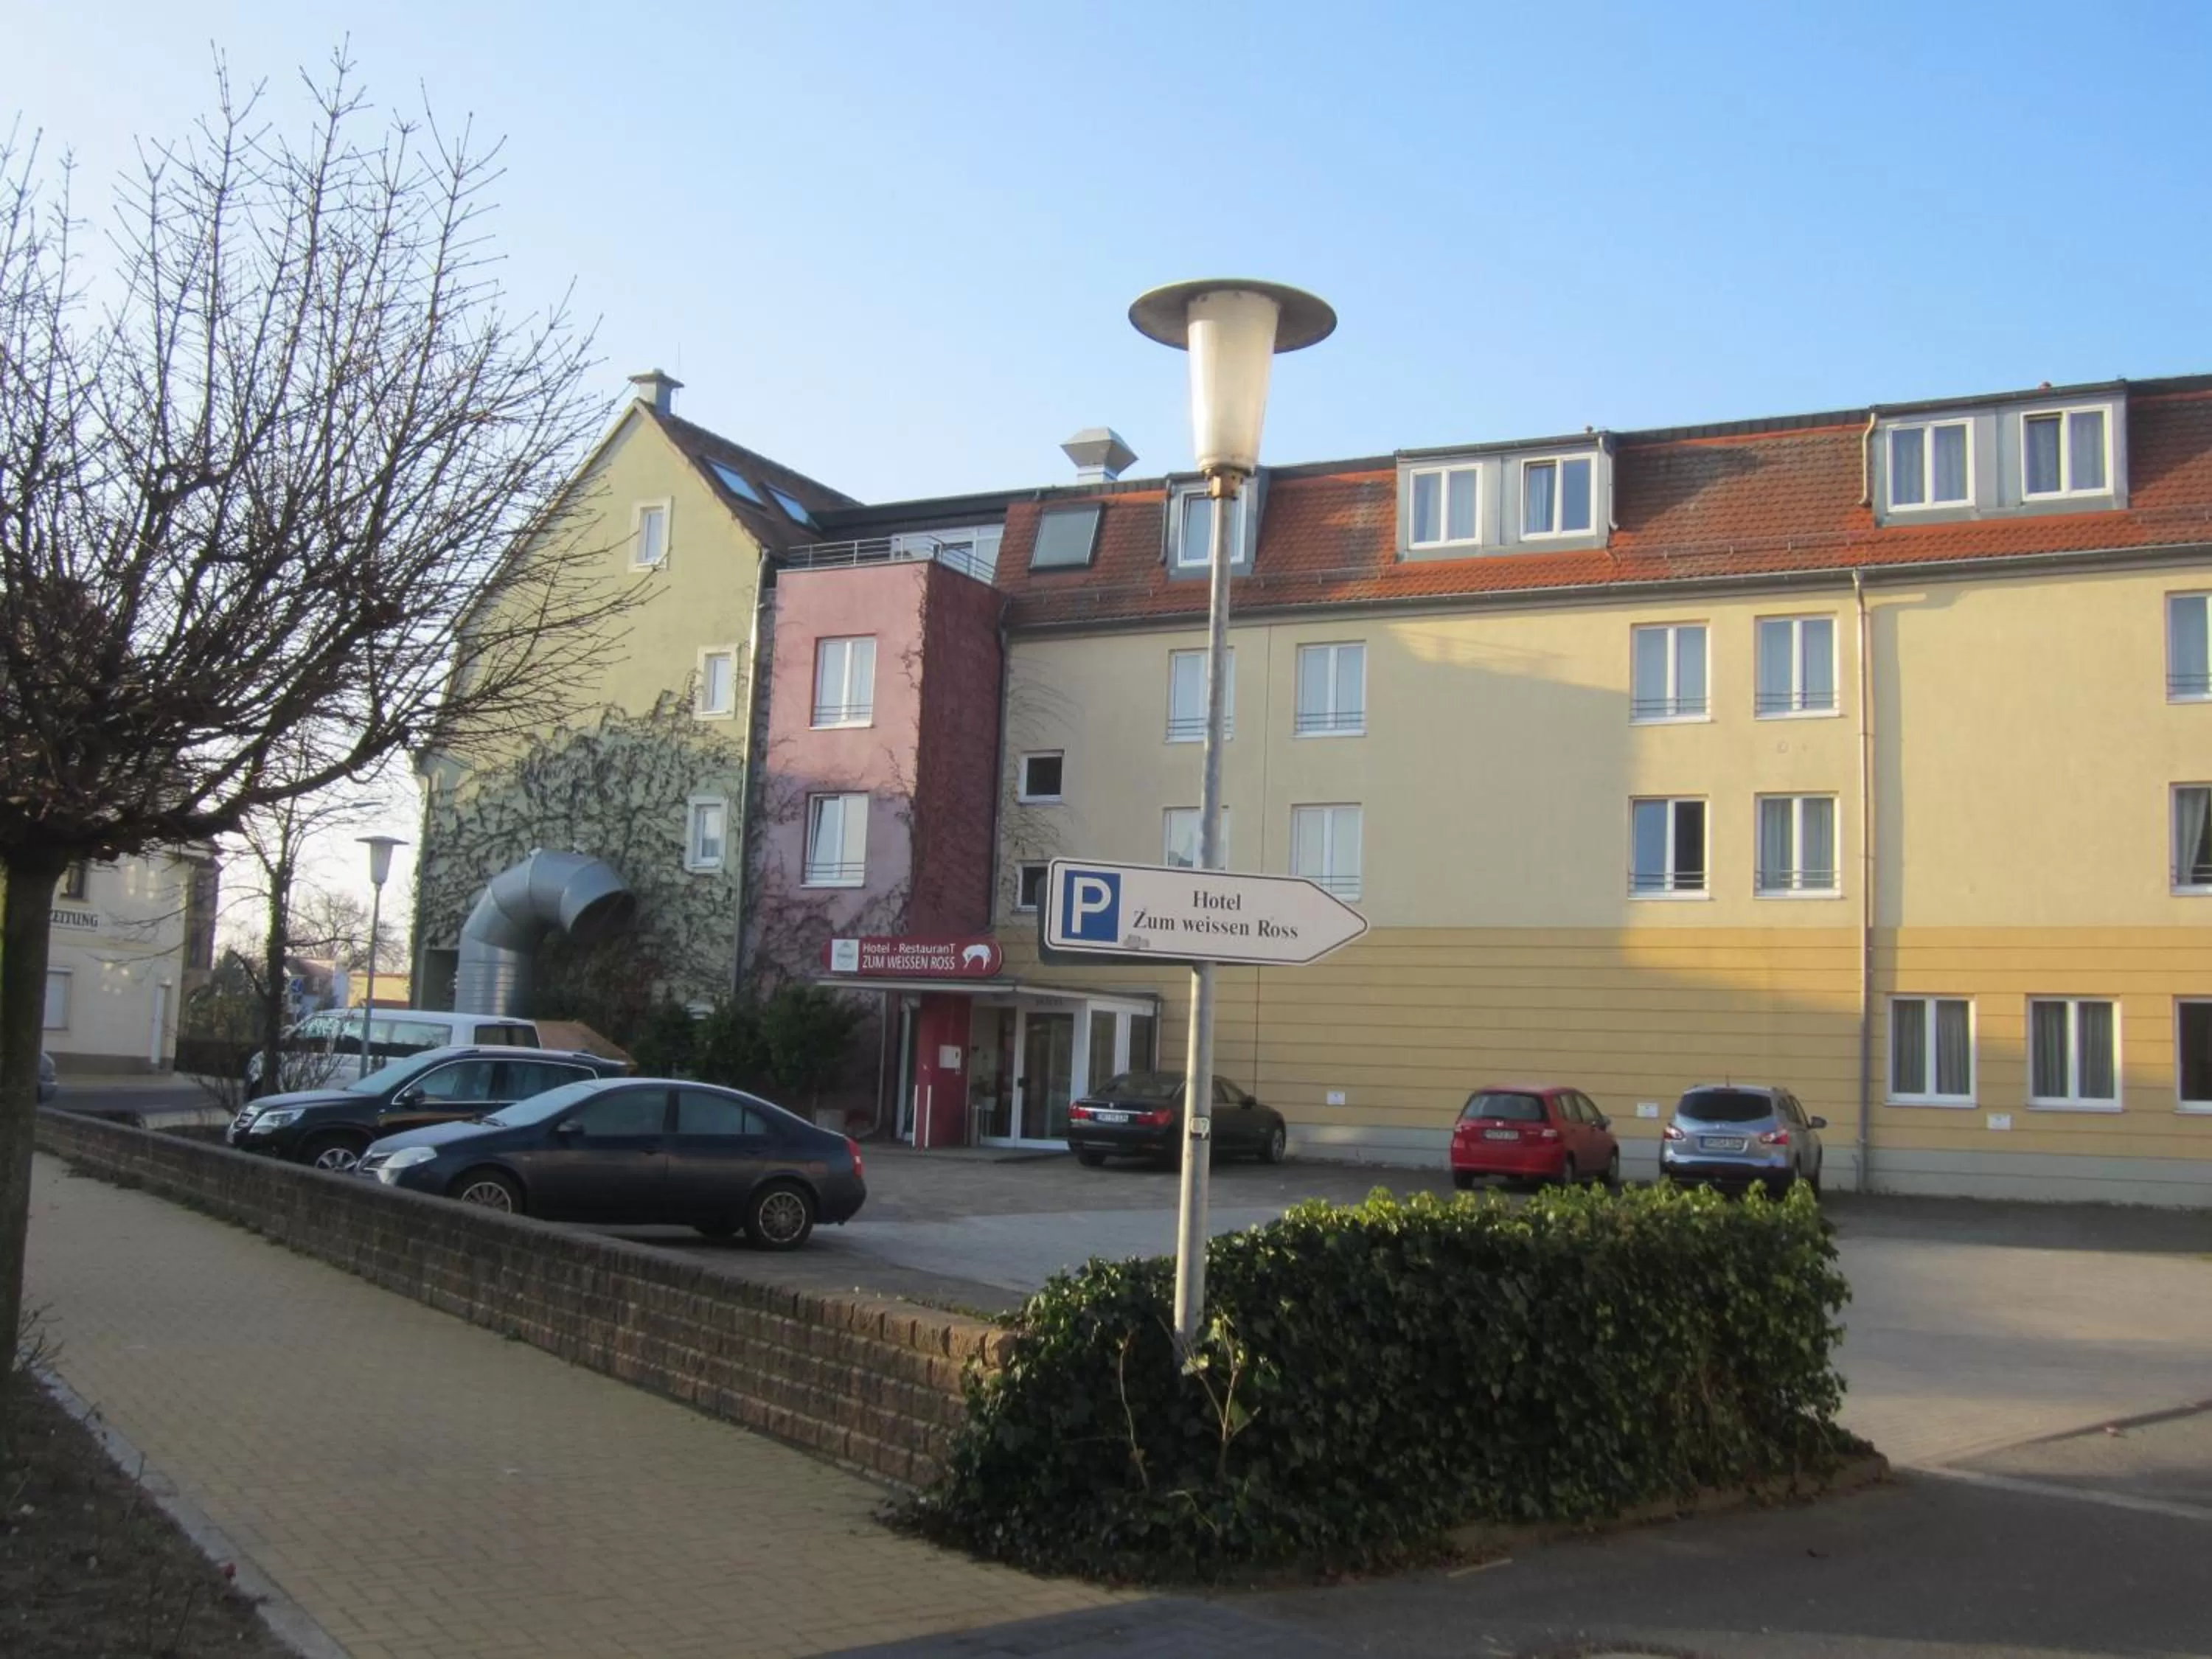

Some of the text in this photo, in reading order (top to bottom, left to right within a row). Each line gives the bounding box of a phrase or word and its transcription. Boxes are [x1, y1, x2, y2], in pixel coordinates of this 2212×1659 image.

[1071, 877, 1112, 933] P
[1193, 891, 1242, 911] Hotel
[50, 909, 98, 927] EITUNG
[1133, 908, 1299, 940] Zum weissen Ross
[863, 943, 890, 953] Hotel
[862, 956, 884, 968] ZUM
[887, 956, 928, 970] WEISSEN
[931, 956, 956, 970] ROSS
